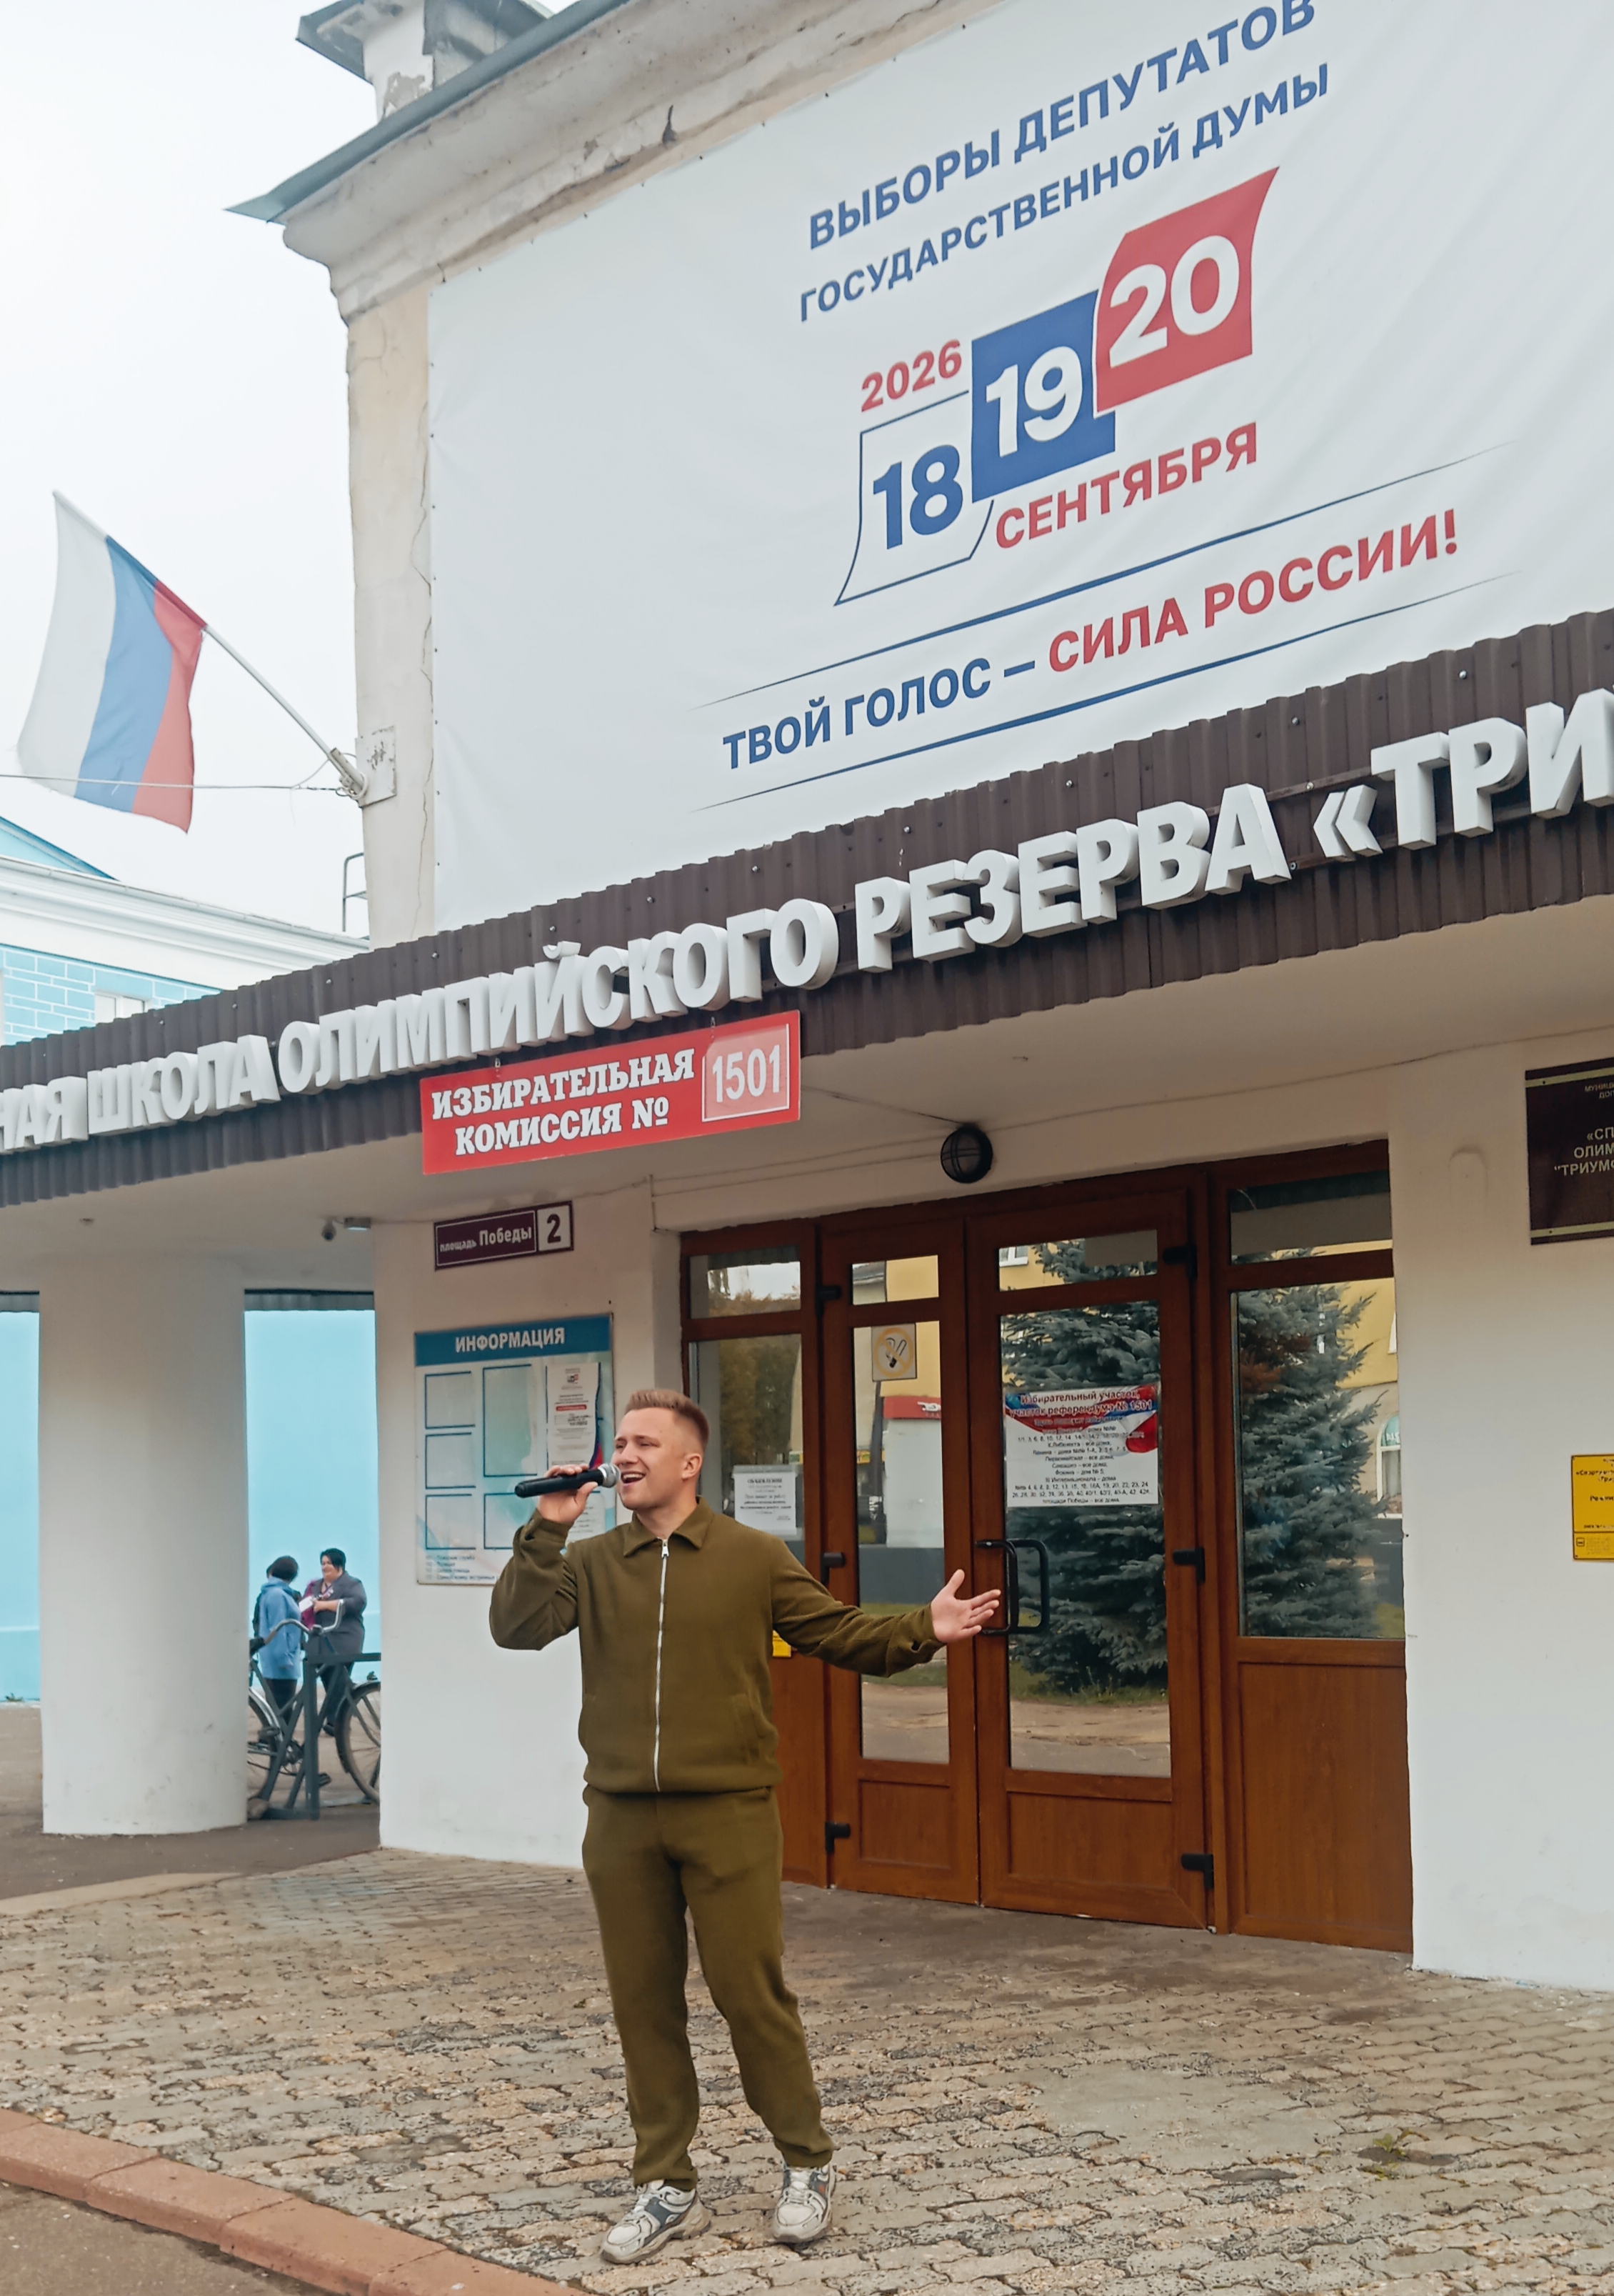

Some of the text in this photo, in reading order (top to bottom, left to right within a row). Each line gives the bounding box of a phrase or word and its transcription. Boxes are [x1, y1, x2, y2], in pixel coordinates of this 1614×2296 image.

[811, 0, 1315, 249] ВЫБОРЫ ДЕПУТАТОВ
[801, 63, 1328, 321] ГОСУДАРСТВЕННОЙ ДУМЫ
[861, 340, 963, 412] 2026
[873, 235, 1240, 550] 18 19 20
[996, 421, 1257, 549] СЕНТЯБРЯ
[723, 697, 831, 770] ТВОЙ
[845, 658, 991, 736] ГОЛОС
[1049, 598, 1188, 672] СИЛА
[1205, 509, 1455, 628] РОССИИ!
[87, 1034, 281, 1137] ШКОЛА
[278, 898, 838, 1094] ОЛИМПИЙСКОГО
[854, 784, 1291, 972] РЕЗЕРВА
[431, 1049, 694, 1120] ИЗБИРАТЕЛЬНАЯ
[455, 1044, 781, 1156] КОМИССИЯ № 1501
[1573, 1142, 1614, 1159] ОЛИМ
[440, 1213, 561, 1252] площадь Победы 2
[456, 1327, 565, 1353] ИНФОРМАЦИЯ
[1021, 1391, 1096, 1404] Избирательный
[1048, 1403, 1114, 1416] референдума
[1130, 1398, 1152, 1409] 1501
